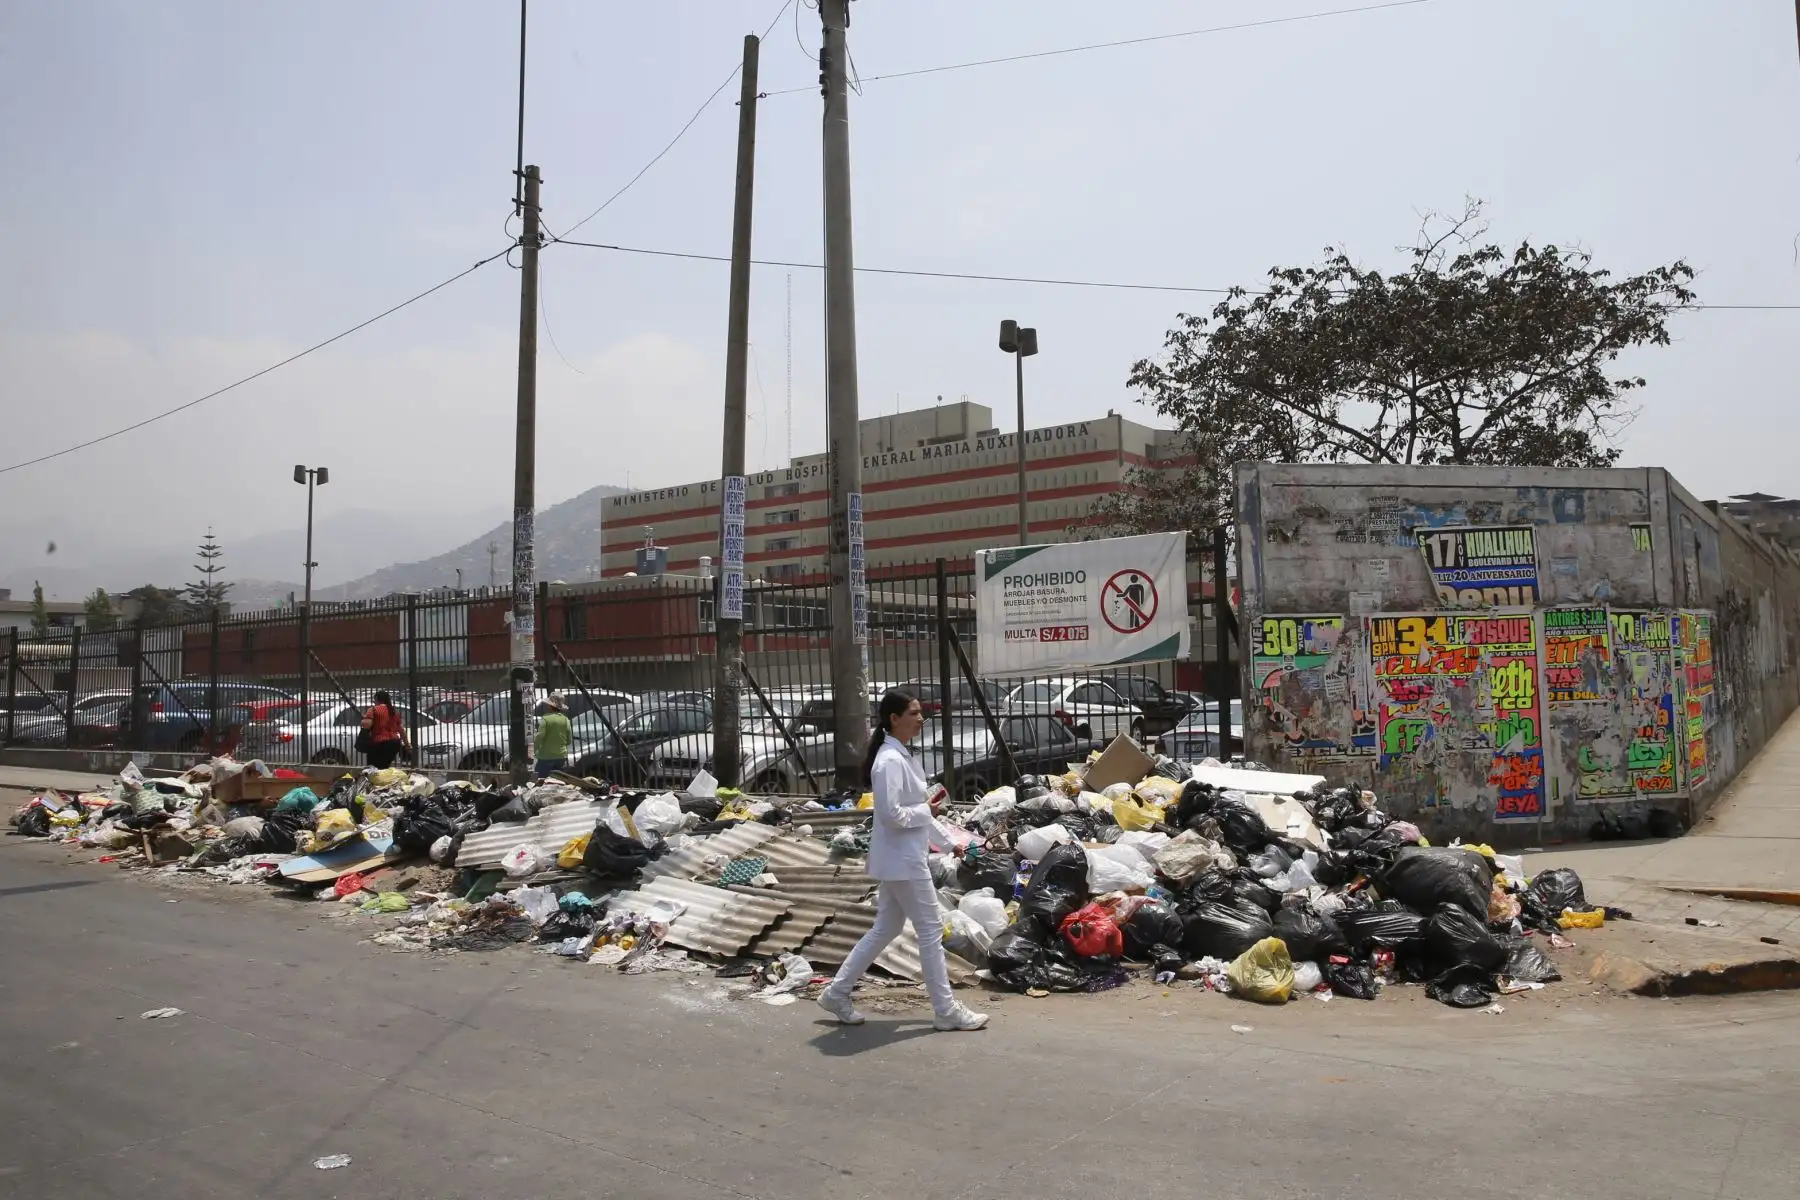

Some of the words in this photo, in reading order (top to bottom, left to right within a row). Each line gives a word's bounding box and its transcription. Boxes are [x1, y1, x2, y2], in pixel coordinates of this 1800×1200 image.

[613, 486, 689, 507] MINISTERIO
[701, 483, 717, 494] DE
[863, 451, 916, 469] ENERAL
[922, 442, 971, 460] MARIA
[976, 422, 1089, 452] AUXIIADORA
[1426, 533, 1456, 567] 17
[1465, 530, 1533, 557] HUALLHUA
[1004, 570, 1087, 589] PROHIBIDO
[1453, 570, 1469, 581] 20
[1470, 569, 1535, 580] ANIVERSARIO!
[1004, 590, 1035, 598] ARROJAR
[1004, 599, 1035, 607] MUEBLES
[1049, 595, 1087, 604] DESMONTE
[1005, 628, 1037, 639] MULTA
[1263, 619, 1298, 656] 30
[1398, 617, 1449, 655] 31
